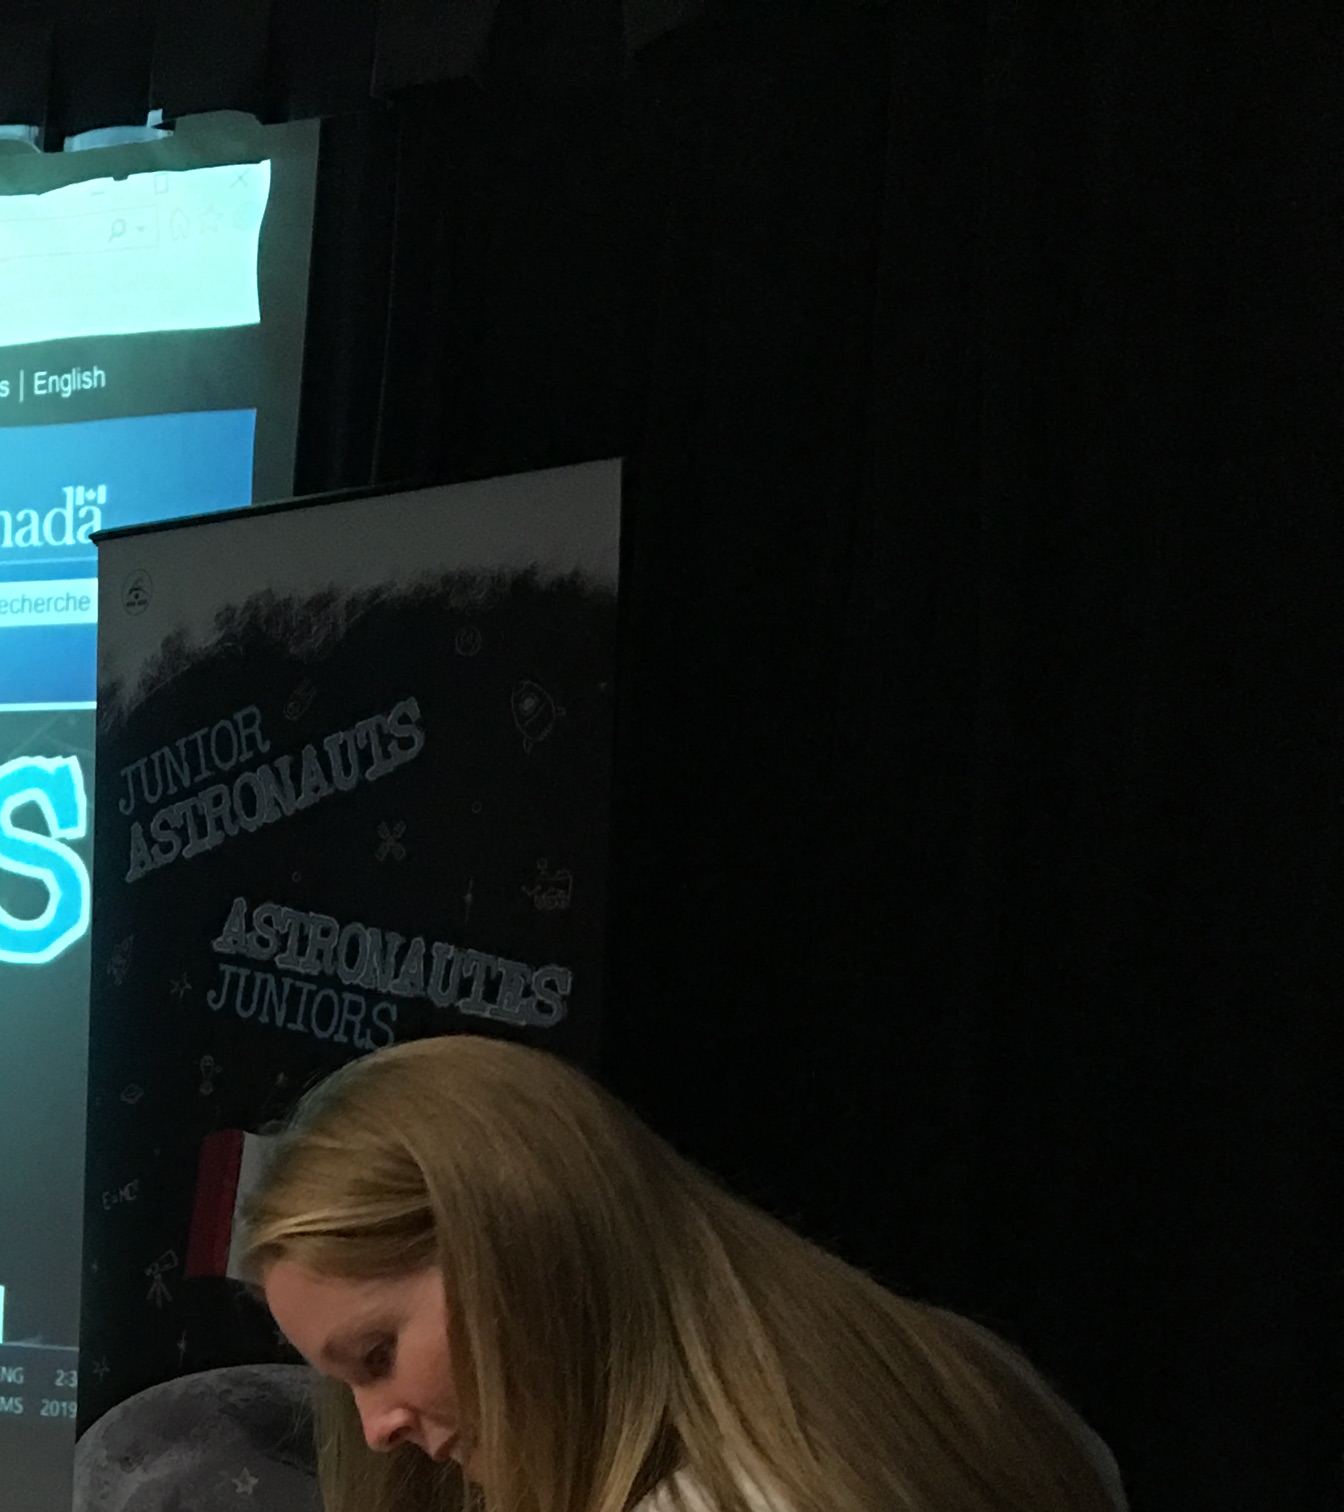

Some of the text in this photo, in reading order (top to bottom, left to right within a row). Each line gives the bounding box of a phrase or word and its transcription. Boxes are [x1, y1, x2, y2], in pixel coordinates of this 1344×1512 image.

[33, 365, 107, 398] English
[118, 705, 271, 815] JUNIOR
[125, 696, 427, 883] ASTRONAUTS
[206, 963, 399, 1050] JUNIORS
[212, 896, 573, 1029] ASTRONAUTES
